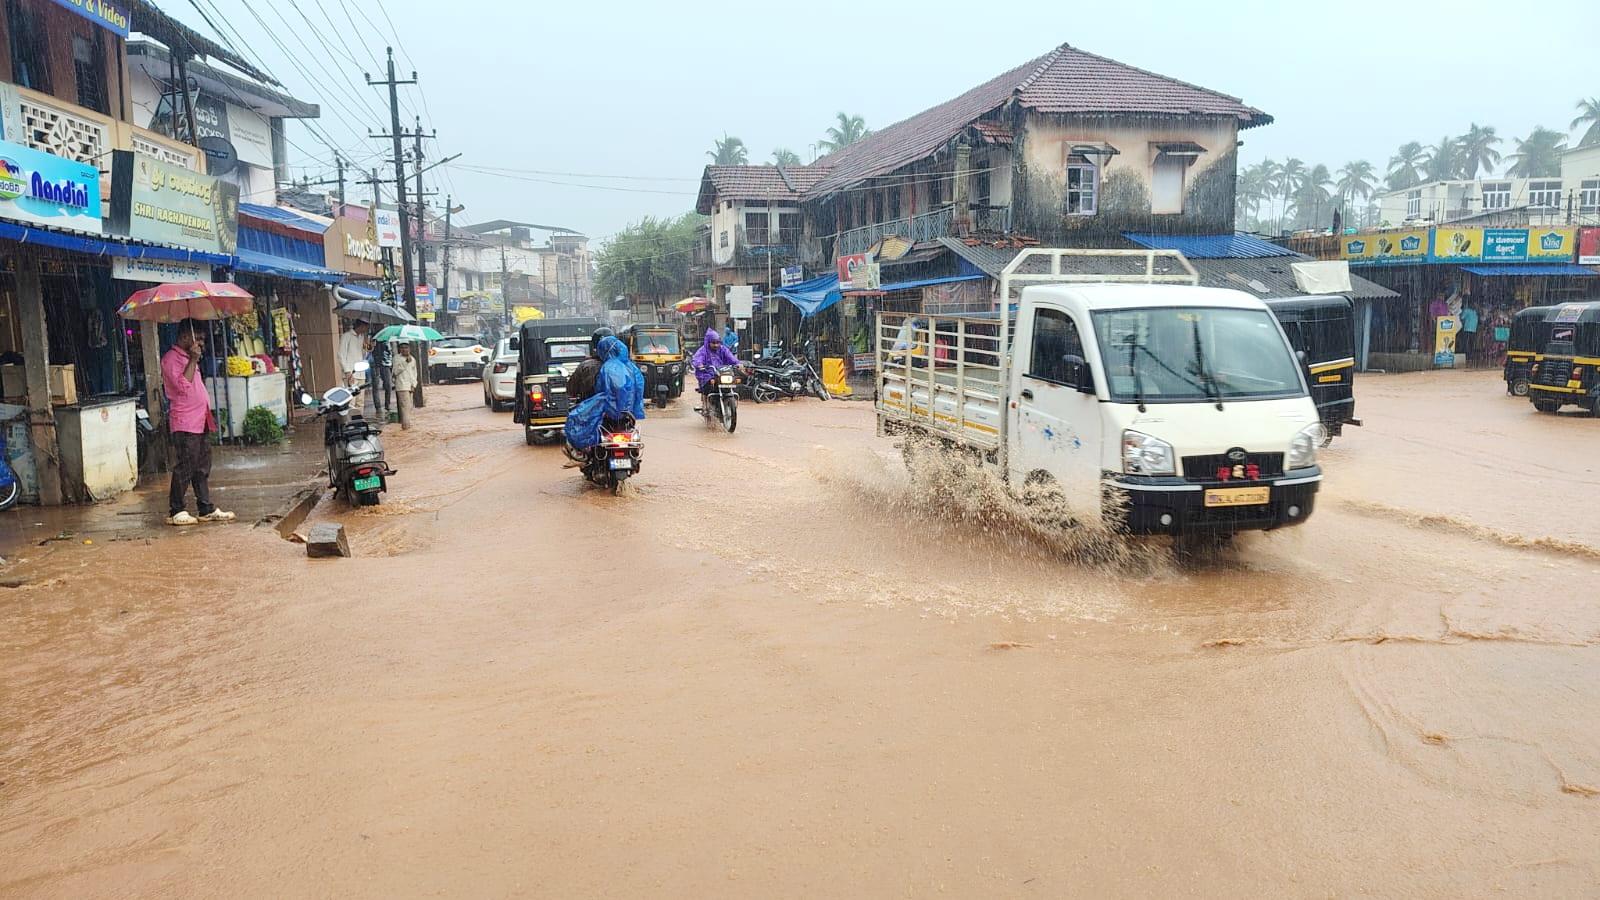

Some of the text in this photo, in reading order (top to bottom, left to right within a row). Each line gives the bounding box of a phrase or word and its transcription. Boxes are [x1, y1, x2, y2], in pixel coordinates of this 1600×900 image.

[97, 0, 126, 29] Video
[31, 171, 89, 208] Nandini
[134, 202, 212, 232] SHRI RAGHAVENDRA
